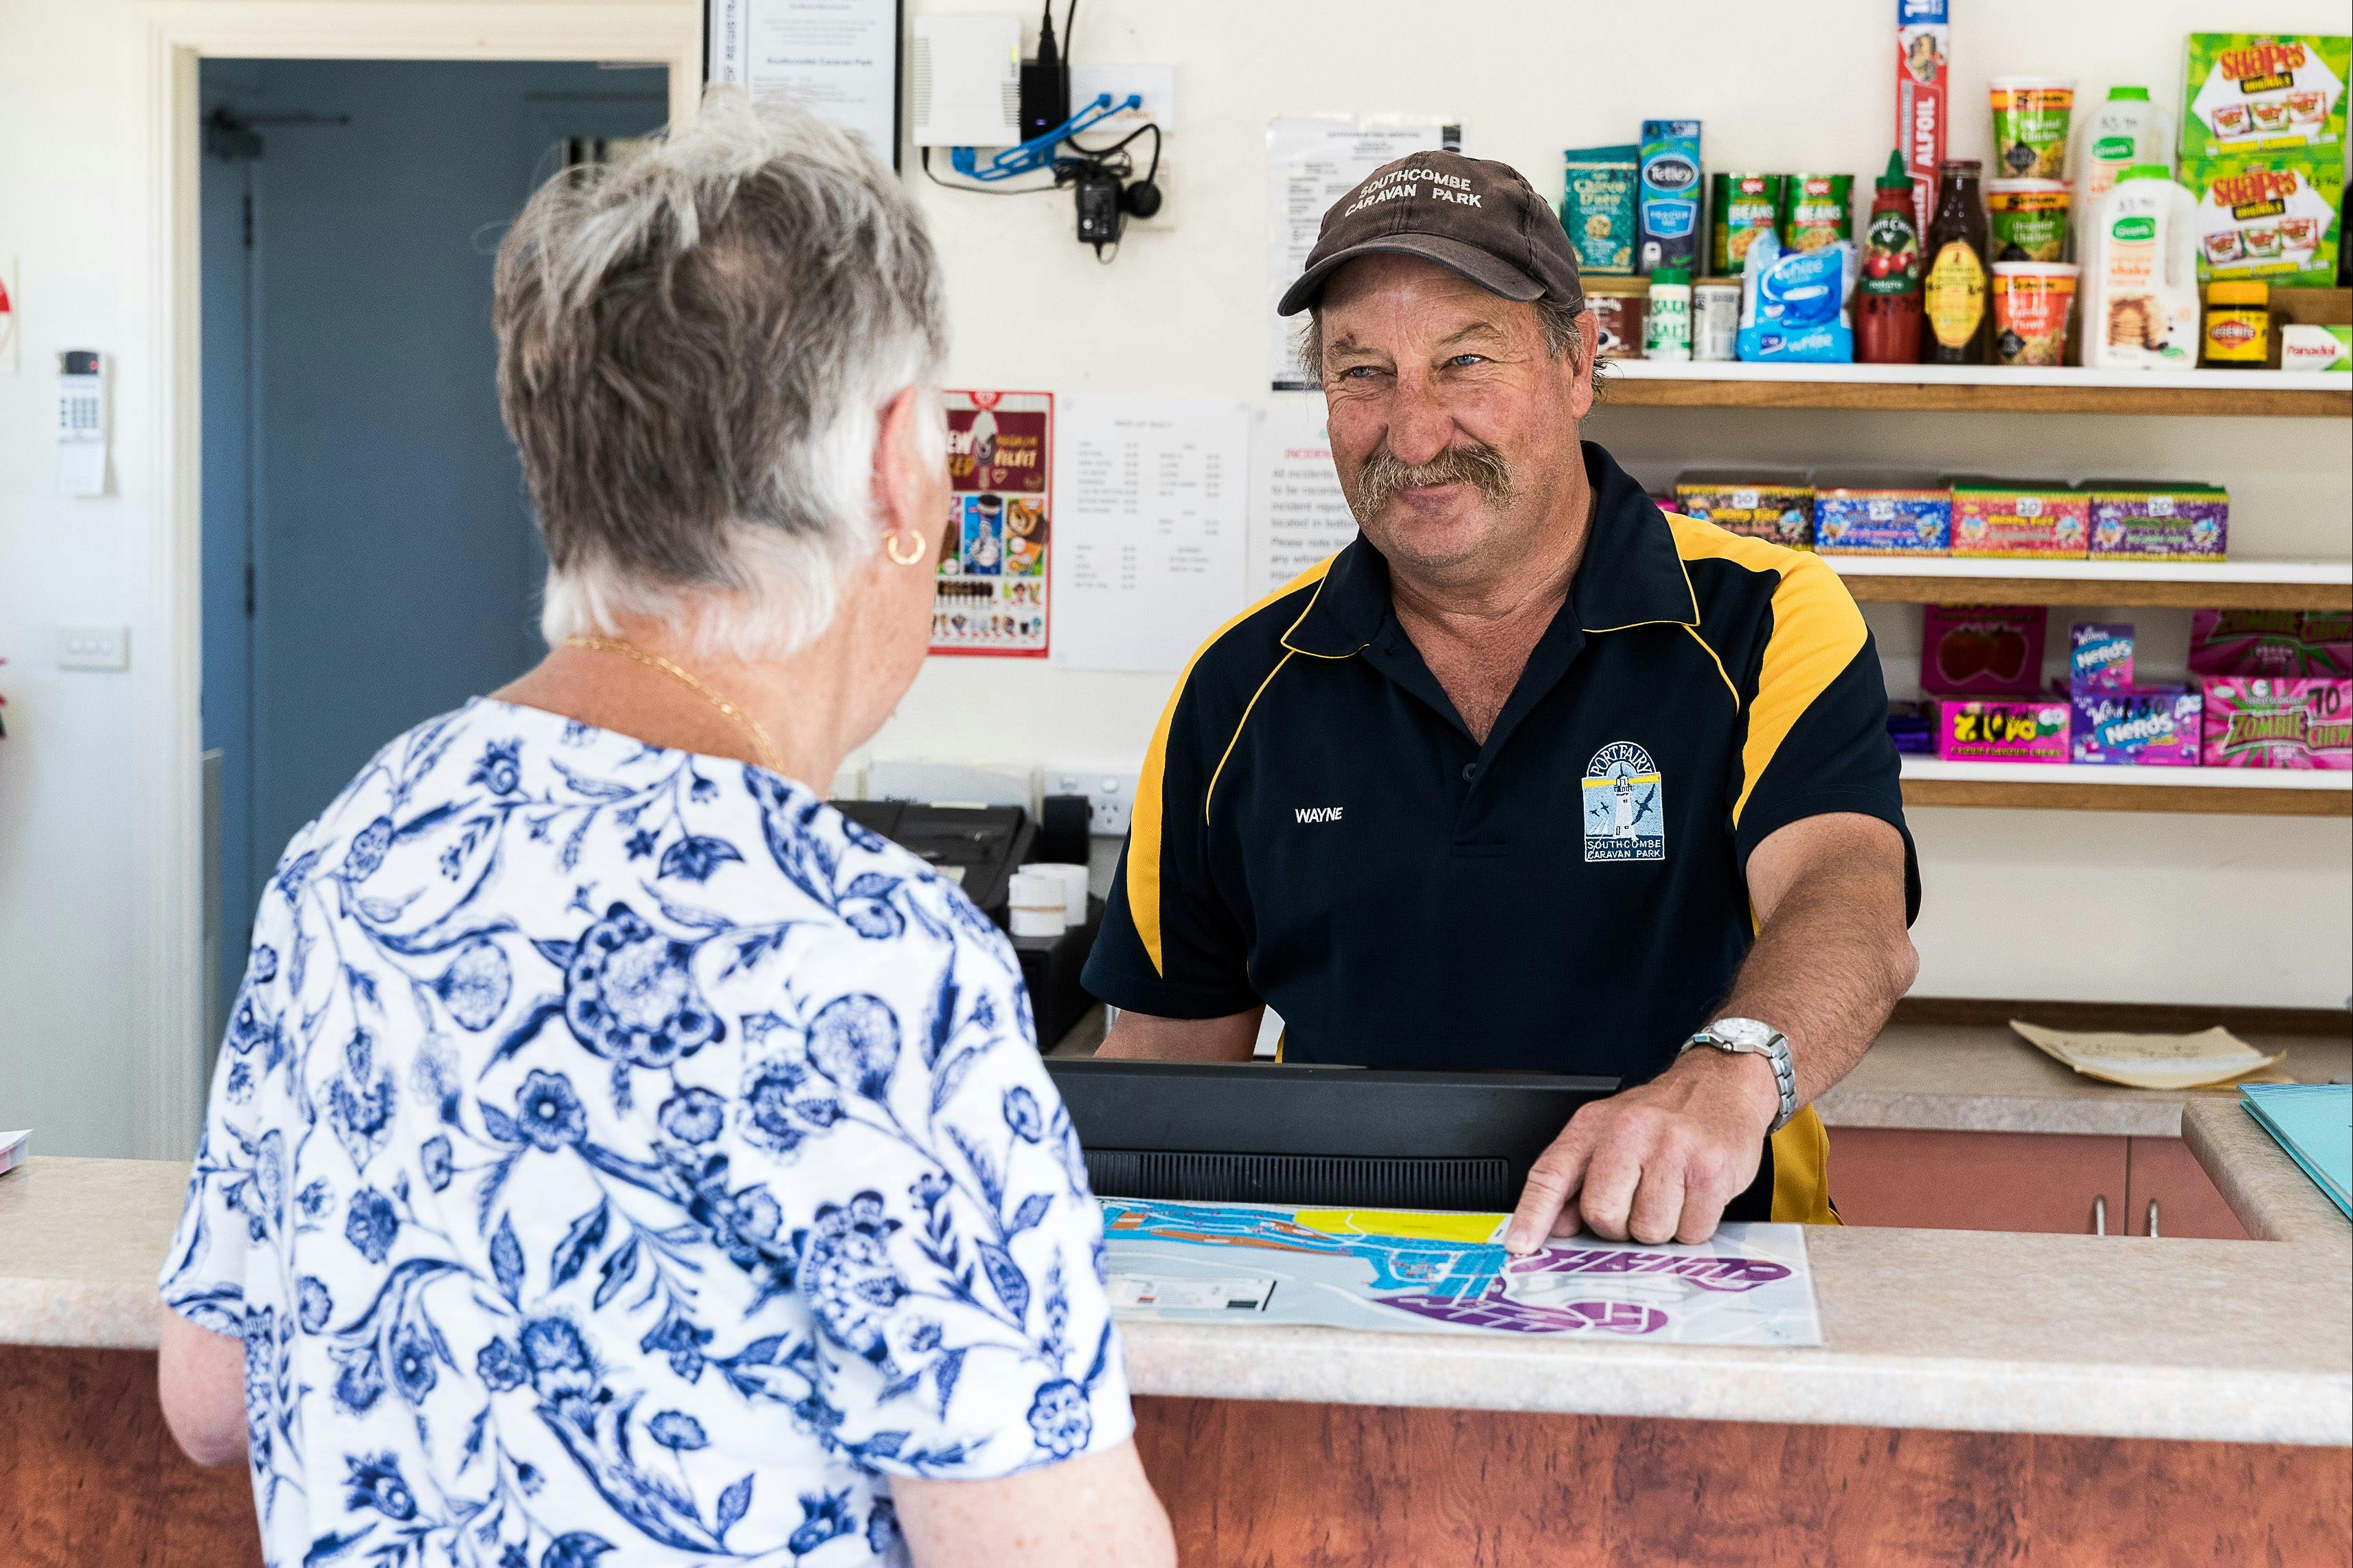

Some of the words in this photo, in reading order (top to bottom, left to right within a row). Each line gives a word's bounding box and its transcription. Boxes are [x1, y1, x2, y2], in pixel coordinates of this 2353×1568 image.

[1914, 97, 1936, 168] ALFOIL
[1359, 168, 1471, 198] SOUTHCOMBE
[1650, 165, 1694, 183] Tetley
[1344, 183, 1417, 217] CARAVAN
[1432, 187, 1482, 208] PARK
[1728, 204, 1775, 219] BEANS
[1793, 205, 1842, 220] BEANS
[1651, 323, 1687, 339] SALT
[2286, 345, 2336, 356] Panadol
[2073, 626, 2110, 645] Wonka
[2308, 686, 2341, 716] 70
[2104, 712, 2176, 746] NERDS
[2227, 713, 2305, 747] ZOMBIE
[1295, 806, 1343, 823] WAYNE
[1587, 839, 1661, 850] SOUTHCOMBE
[1587, 850, 1631, 859] CARAVAN
[1636, 848, 1661, 857] PARK
